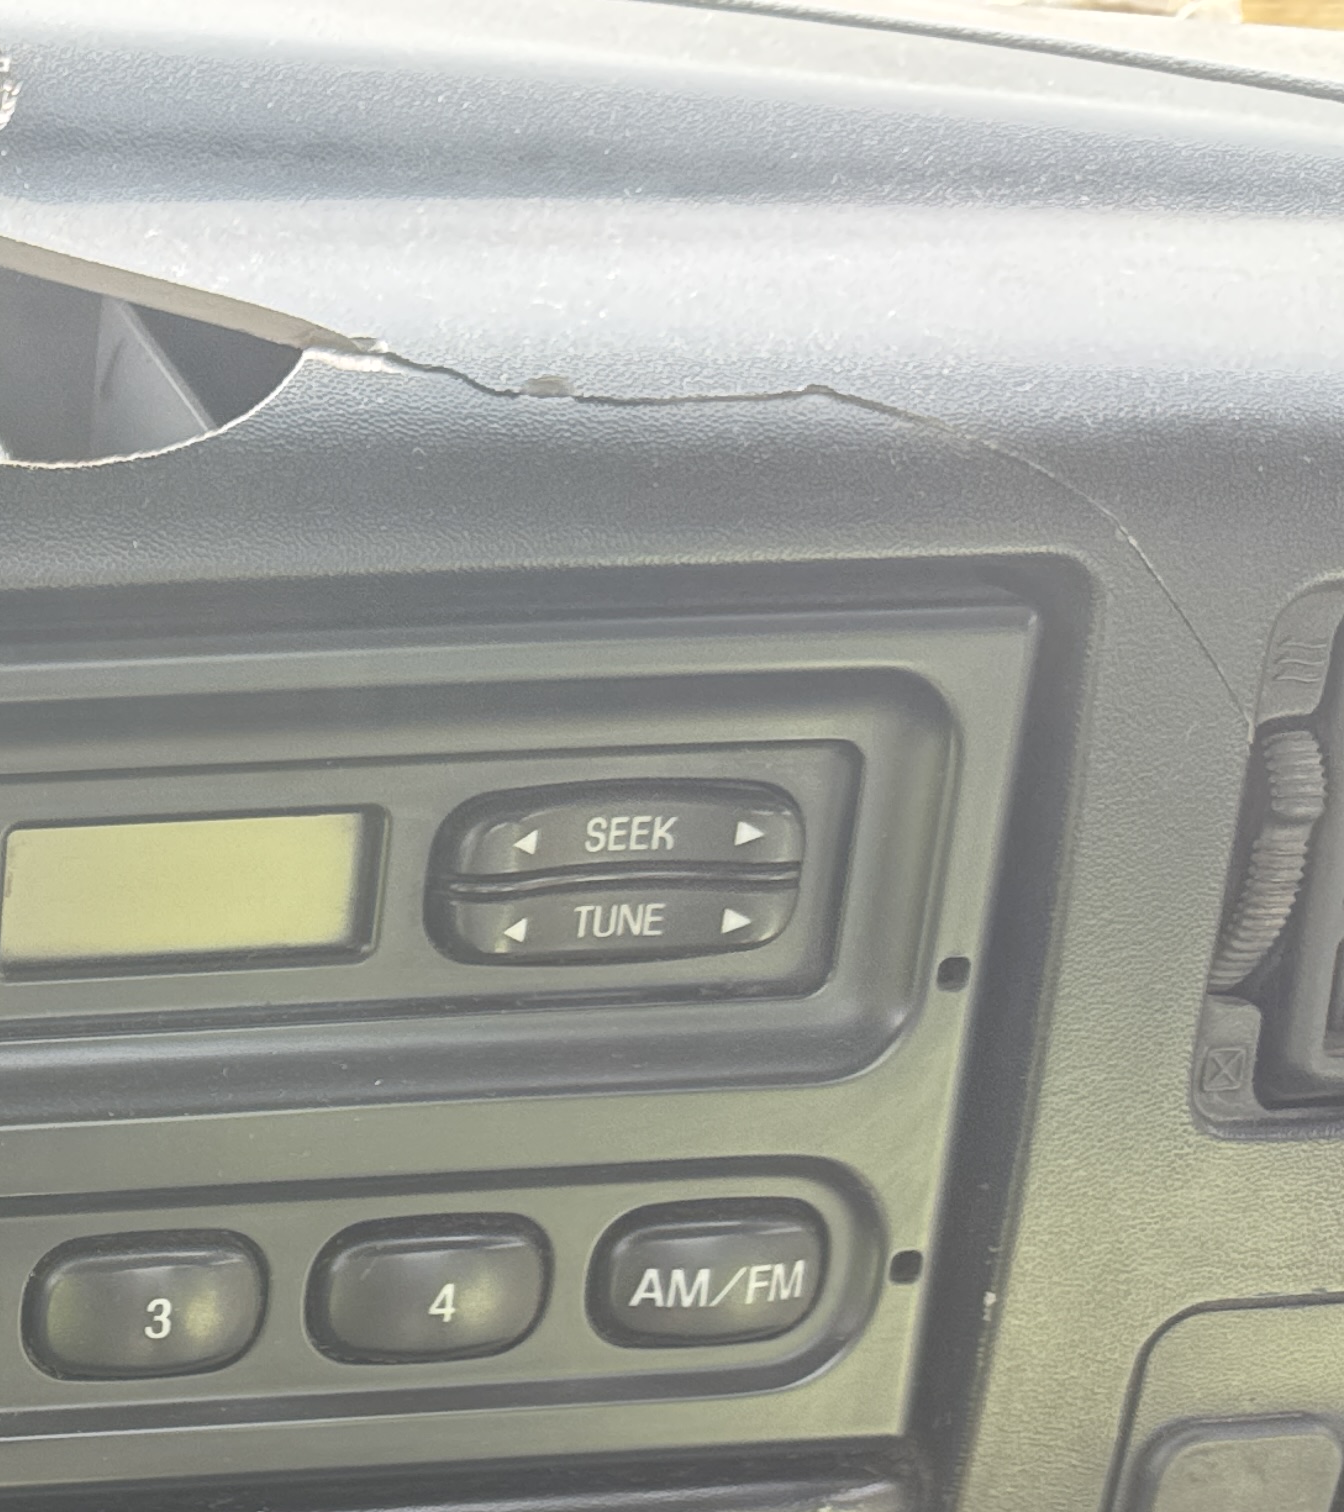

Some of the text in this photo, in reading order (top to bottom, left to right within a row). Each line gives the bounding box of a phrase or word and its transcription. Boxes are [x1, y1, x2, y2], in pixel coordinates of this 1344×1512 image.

[584, 815, 680, 854] SEEK
[573, 904, 667, 938] TUNE
[427, 1281, 458, 1324] 4
[628, 1258, 808, 1310] AM/FM
[144, 1298, 173, 1341] 3
